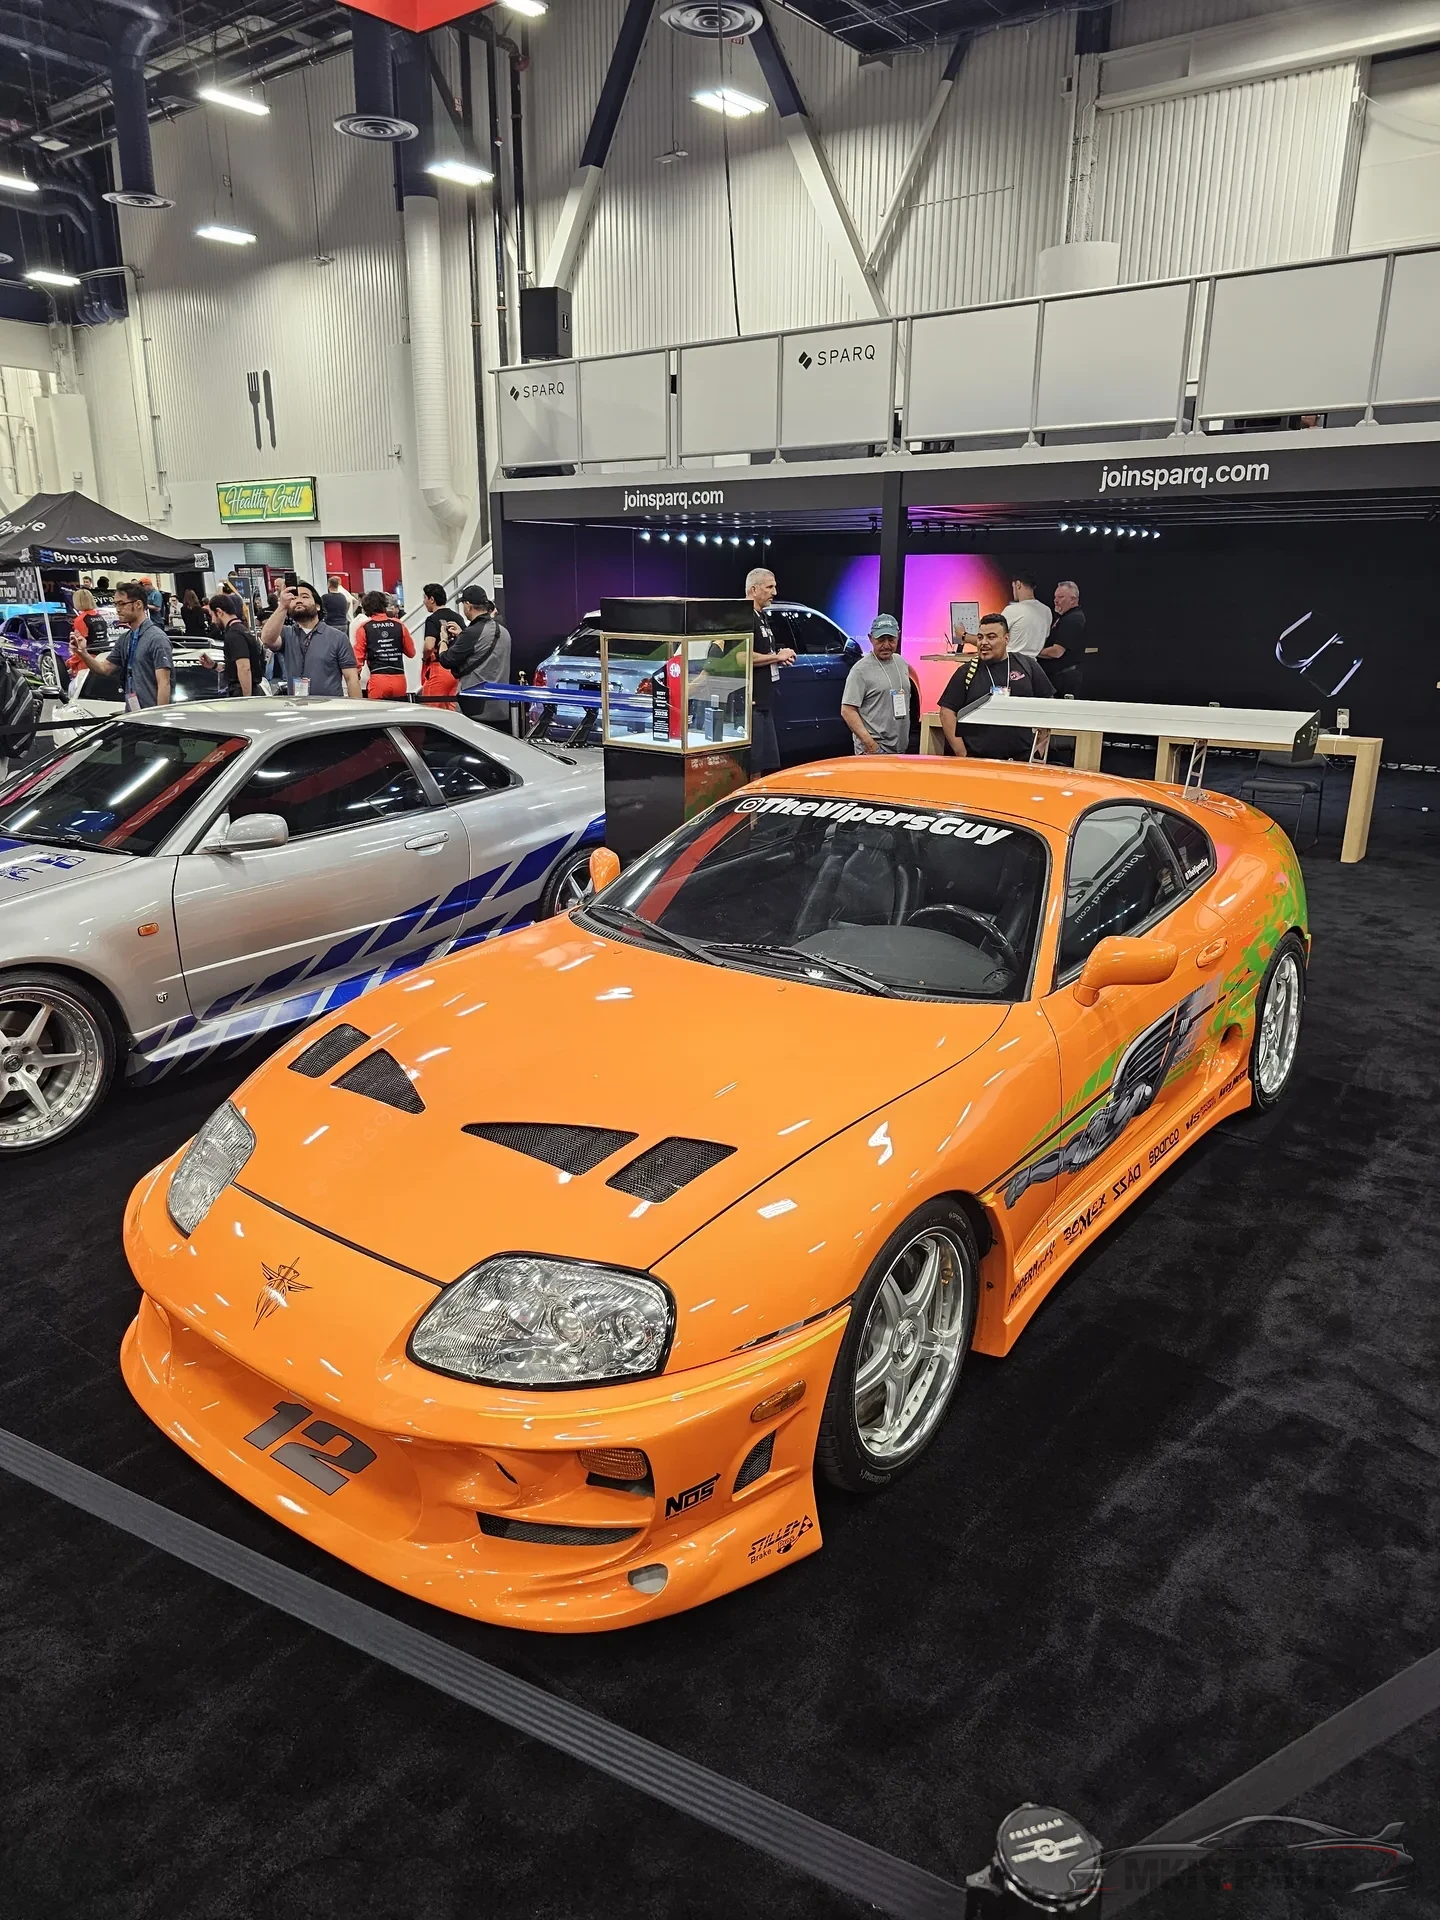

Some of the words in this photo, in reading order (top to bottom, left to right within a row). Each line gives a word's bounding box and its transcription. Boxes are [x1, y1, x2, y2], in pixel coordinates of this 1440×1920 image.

[817, 344, 876, 366] SPARQ
[523, 381, 565, 398] SPARQ
[1098, 463, 1270, 493] joinsparq.com
[225, 485, 270, 520] Healthy
[271, 483, 304, 516] Grill
[623, 489, 724, 511] joinsparq.com
[82, 533, 149, 544] Gyraline
[53, 551, 118, 565] Gyraline
[1148, 1128, 1180, 1167] sparco
[1063, 1193, 1108, 1246] BOMEX
[243, 1400, 378, 1497] 12
[664, 1476, 718, 1521] NOS
[750, 1548, 772, 1564] Brake
[1008, 1818, 1065, 1841] FREEMAN
